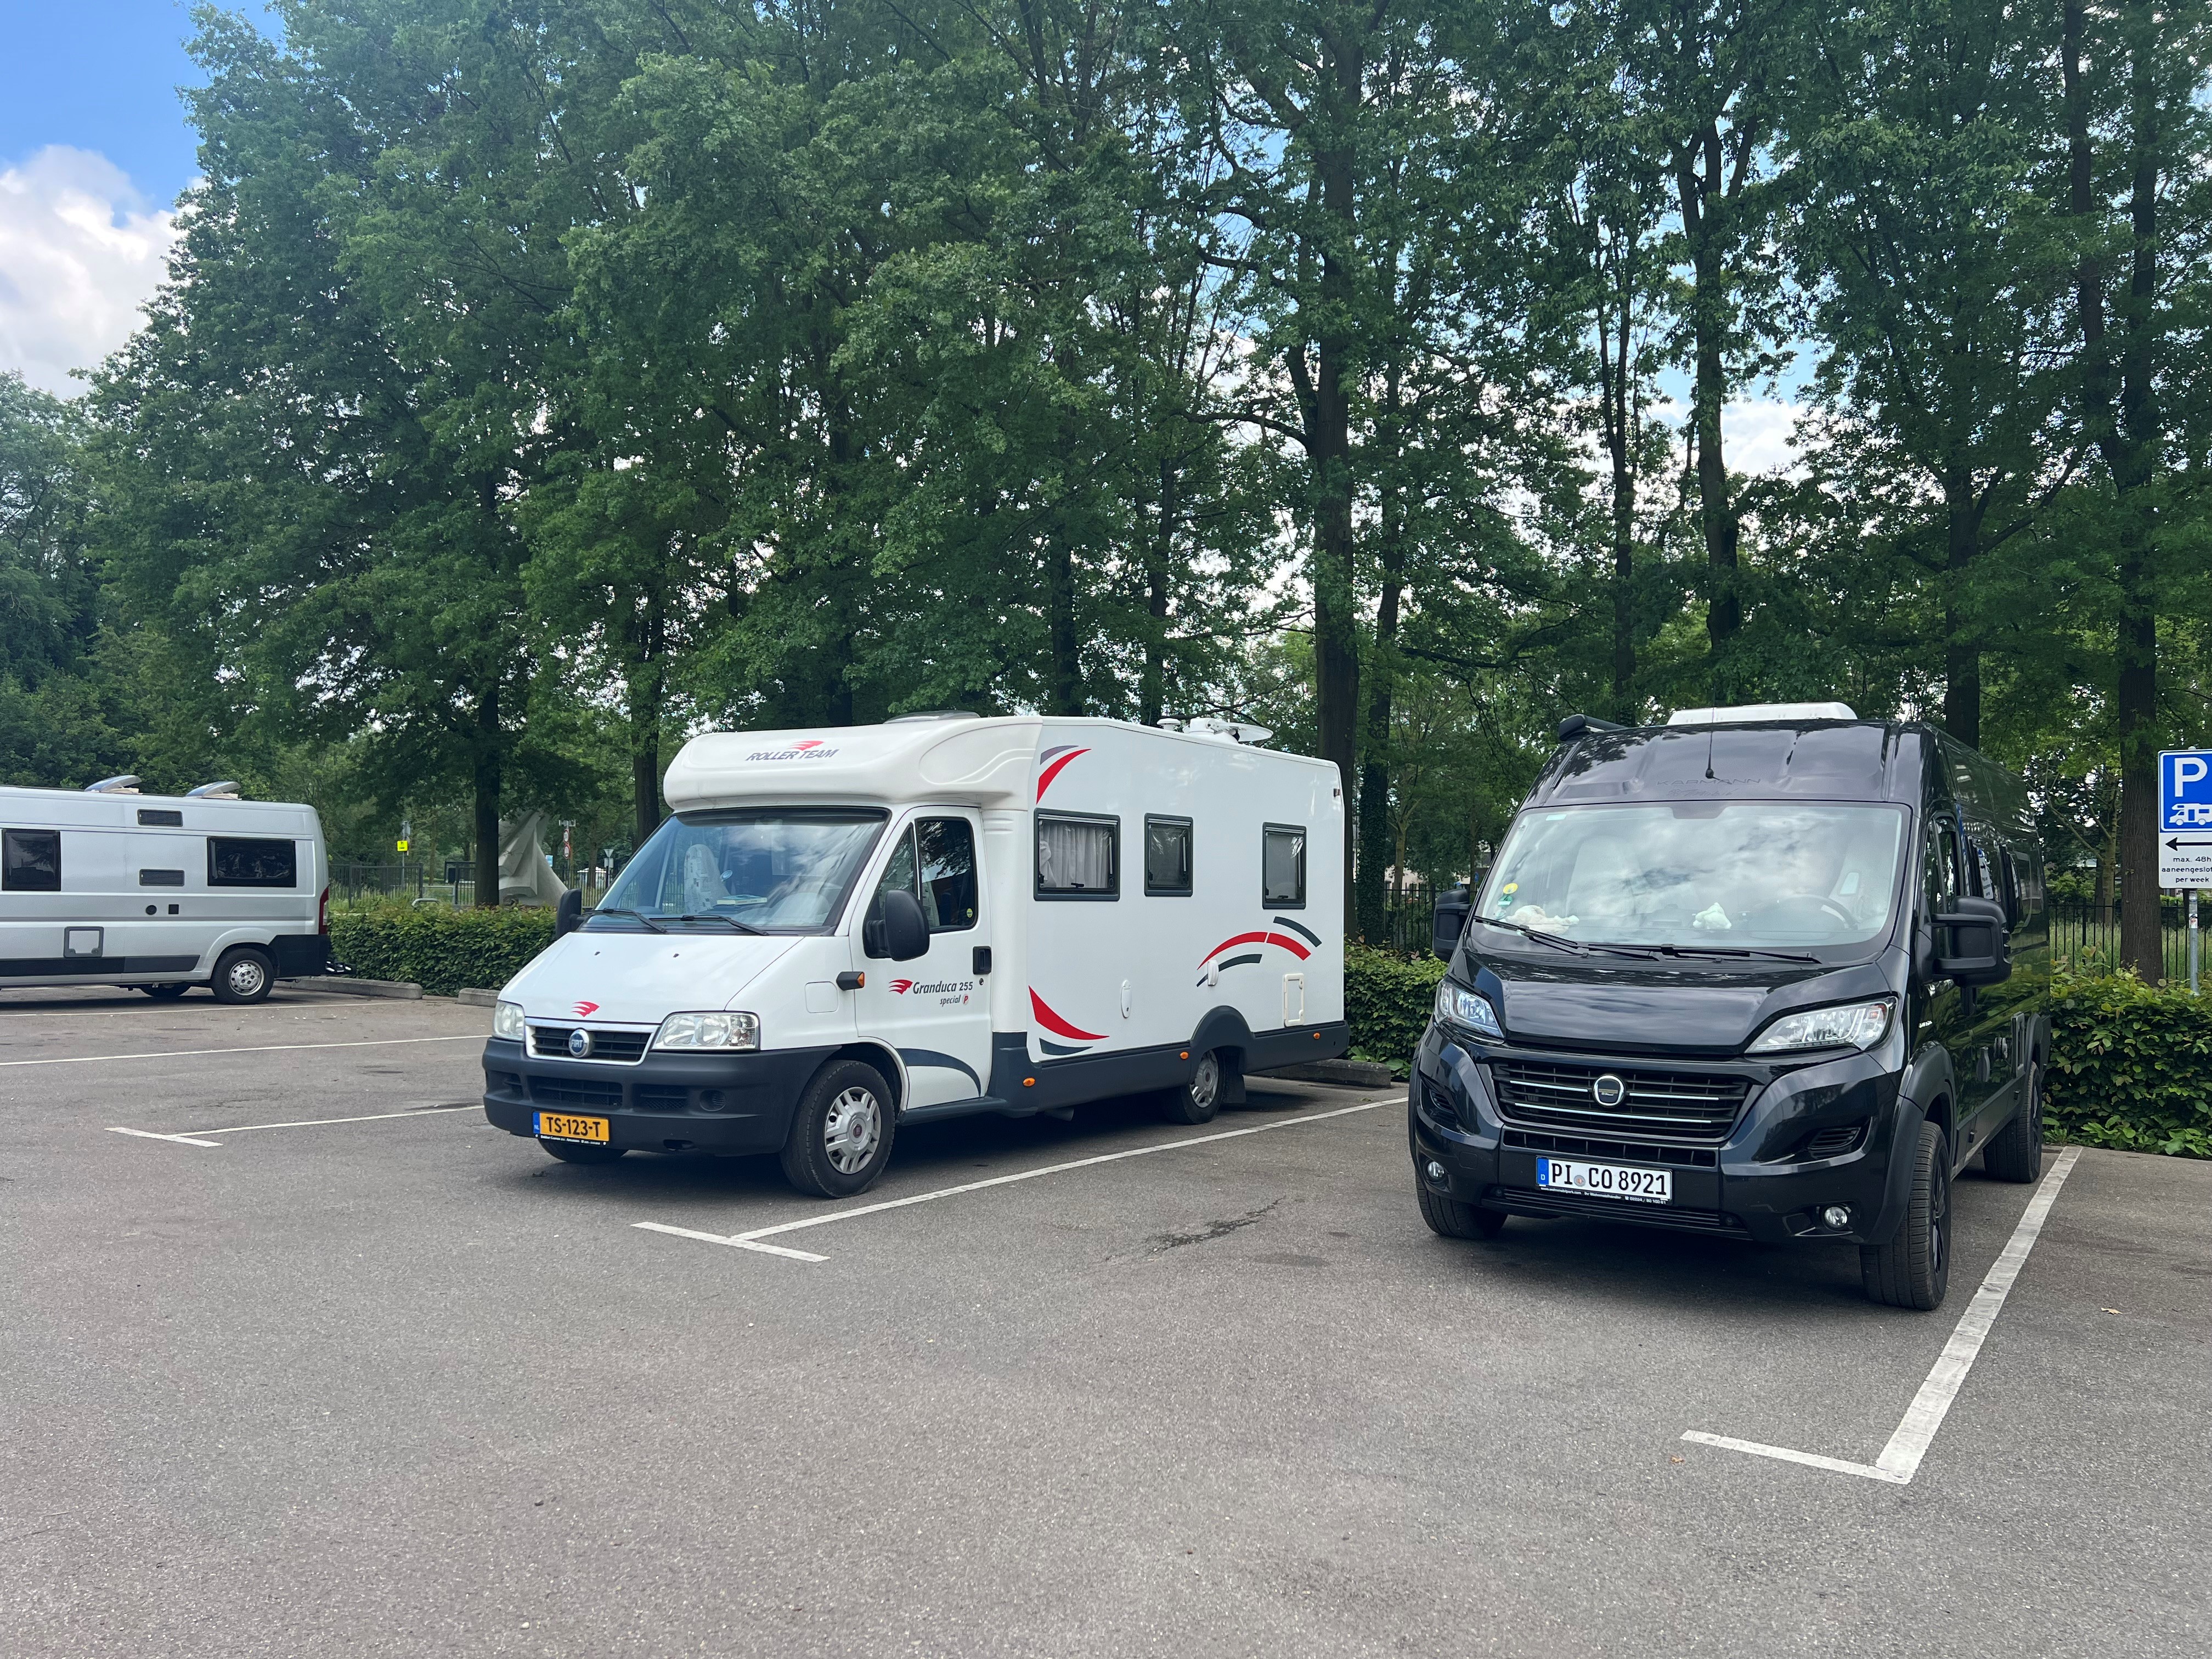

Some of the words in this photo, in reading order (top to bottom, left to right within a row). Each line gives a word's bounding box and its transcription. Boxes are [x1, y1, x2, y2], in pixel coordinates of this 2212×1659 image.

[744, 751, 799, 761] ROLLER
[798, 748, 840, 759] TEAM
[2174, 757, 2208, 798] P
[913, 980, 957, 994] Granduca
[959, 981, 973, 991] 255
[940, 995, 961, 1007] special
[571, 1039, 583, 1048] FIAT
[546, 1116, 601, 1137] TS-123-T
[1551, 1163, 1573, 1185] PI
[1588, 1167, 1613, 1189] CO
[1618, 1170, 1667, 1195] 8921
